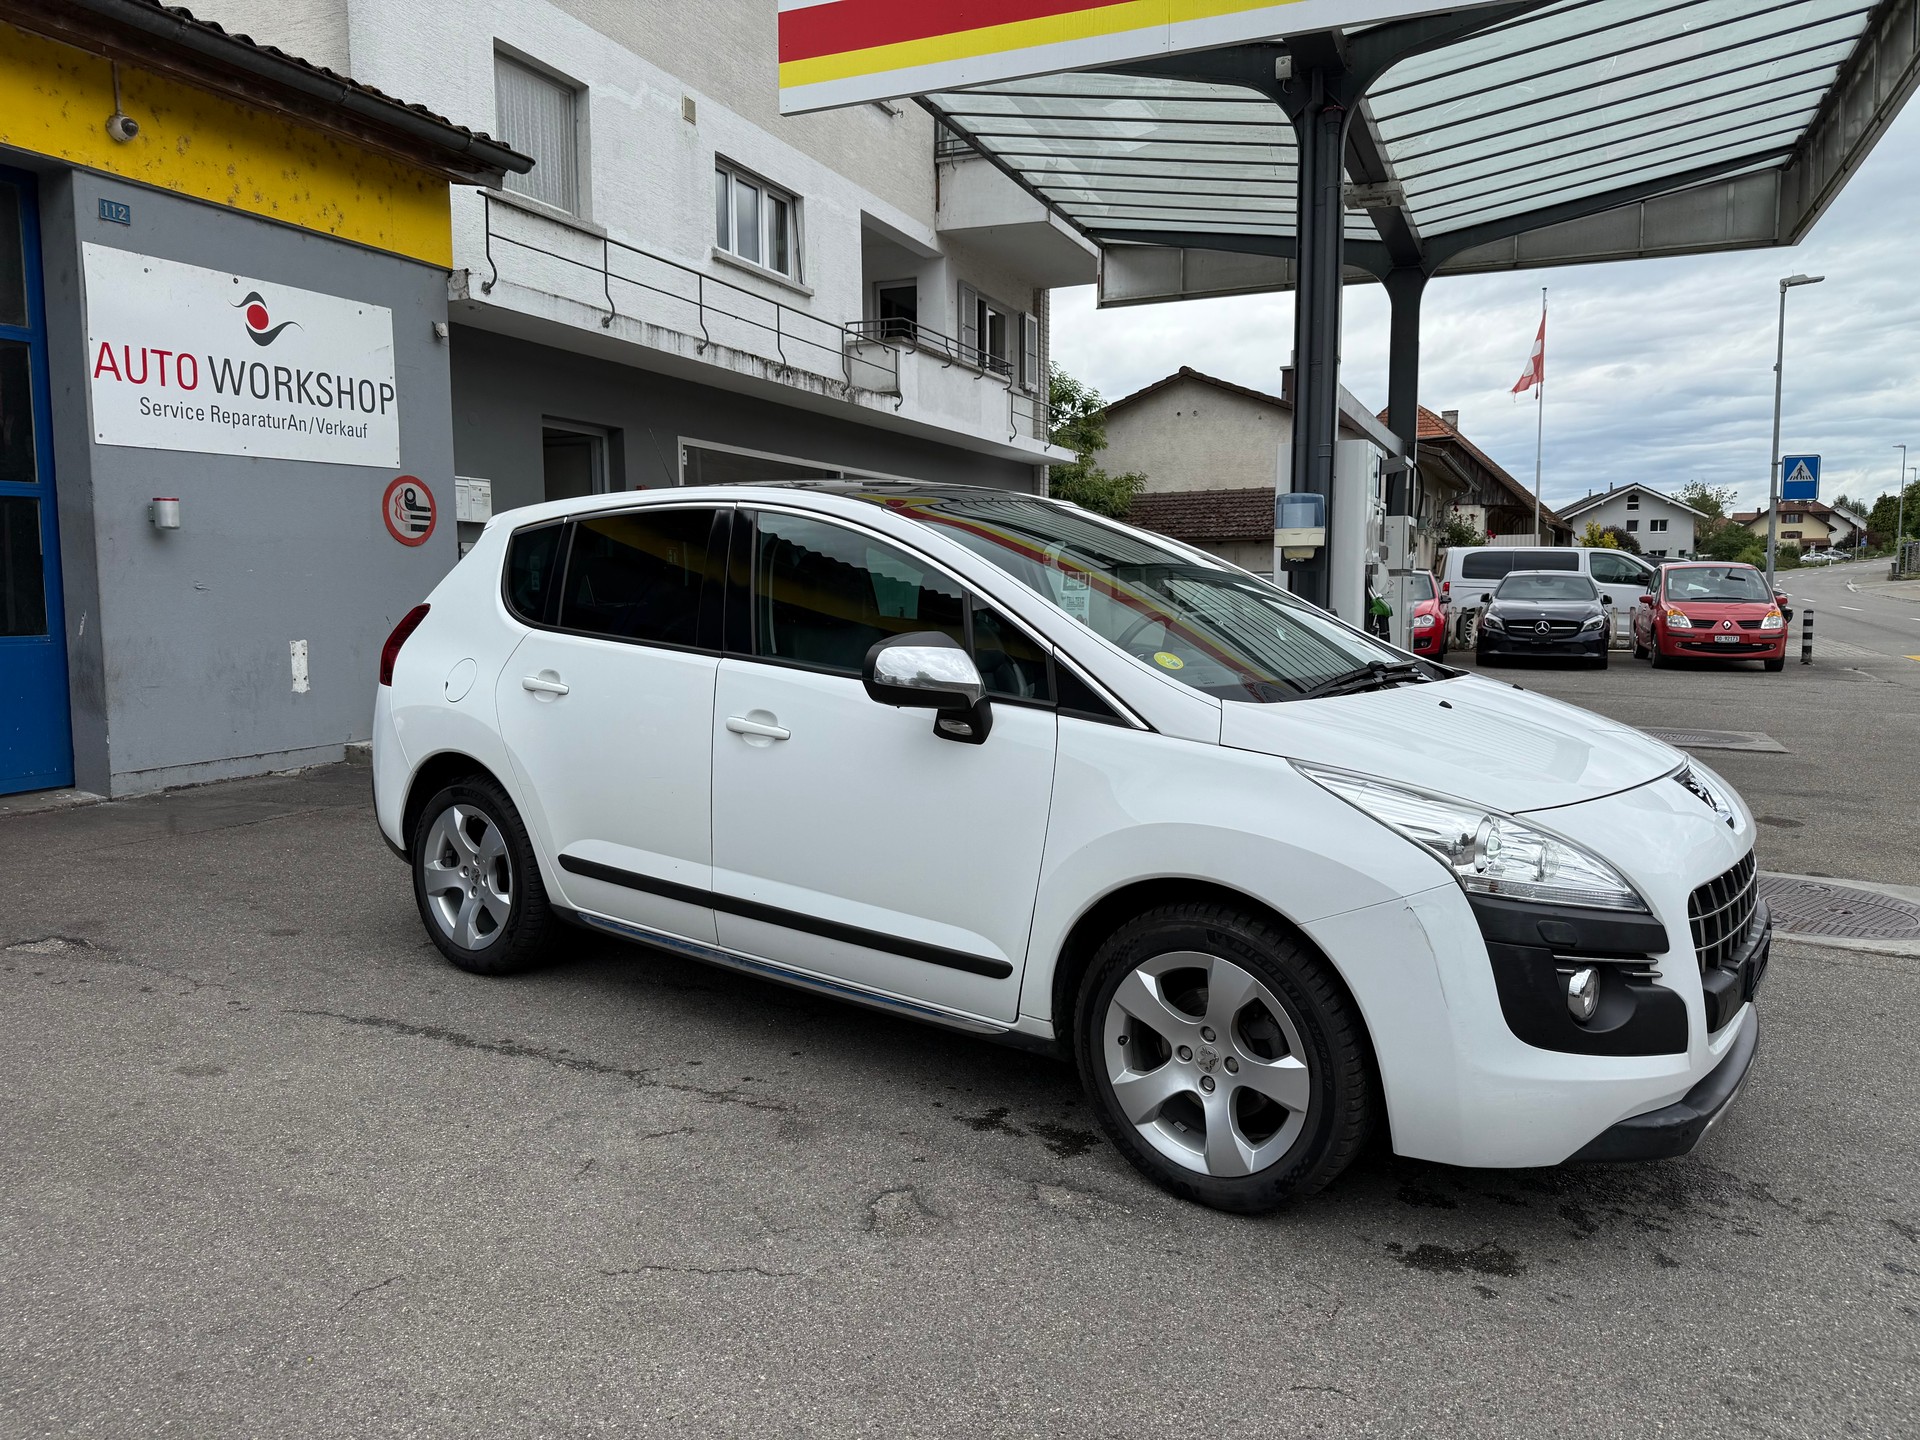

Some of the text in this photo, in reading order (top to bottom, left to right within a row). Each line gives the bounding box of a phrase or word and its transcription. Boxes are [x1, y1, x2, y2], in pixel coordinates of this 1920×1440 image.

[103, 202, 127, 220] 112
[93, 341, 395, 415] AUTO WORKSHOP
[140, 396, 205, 422] Service
